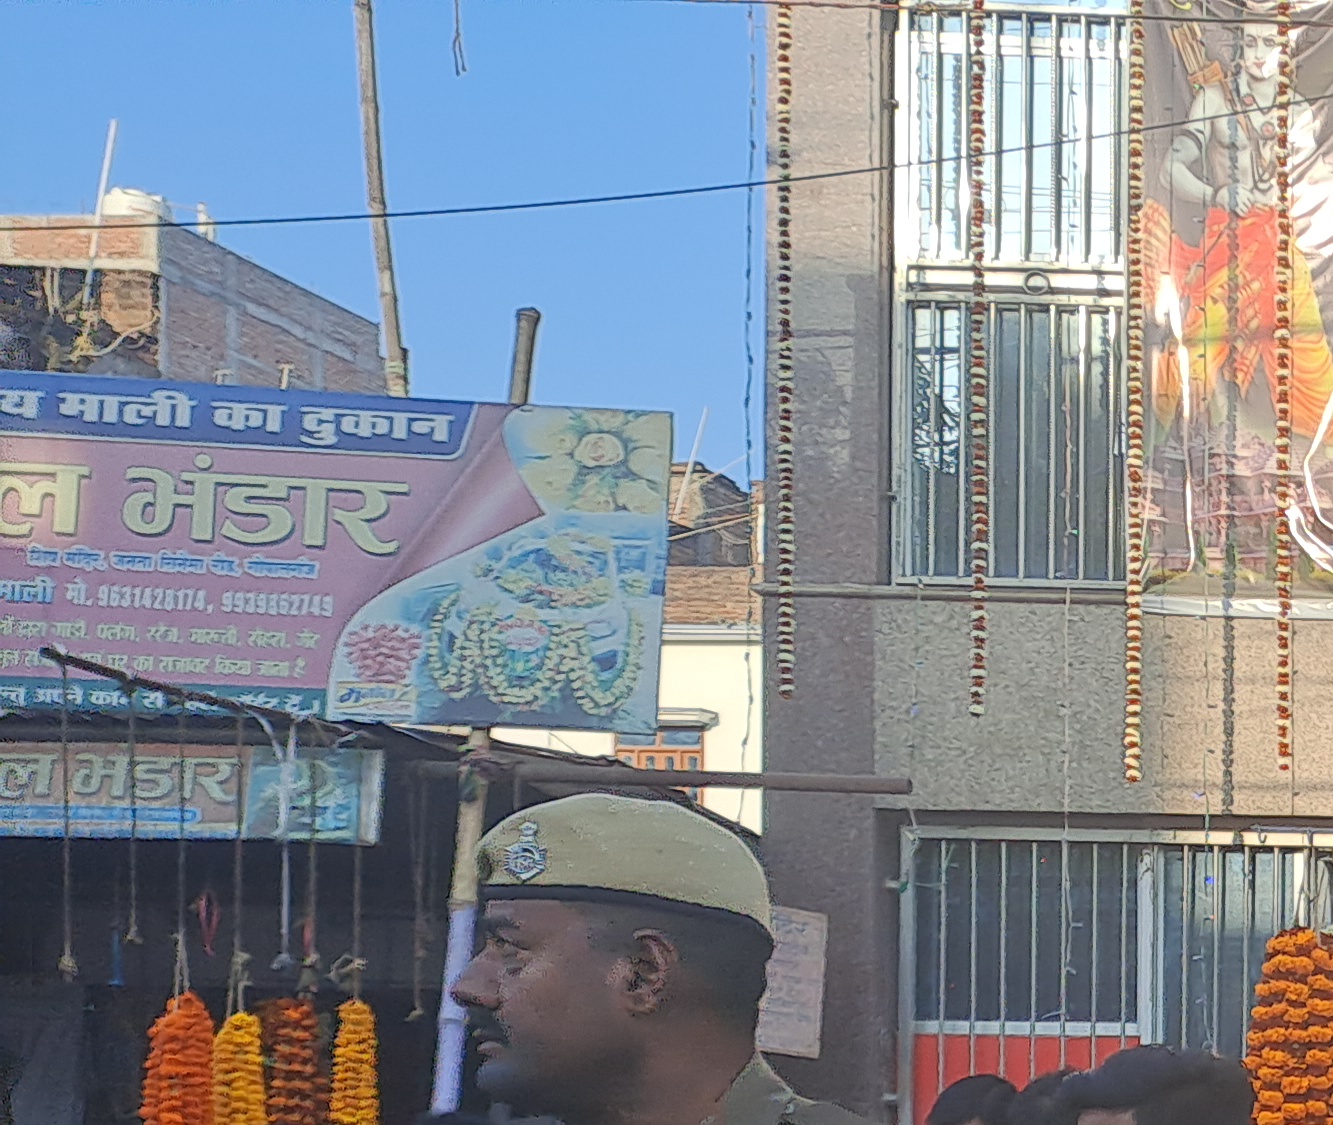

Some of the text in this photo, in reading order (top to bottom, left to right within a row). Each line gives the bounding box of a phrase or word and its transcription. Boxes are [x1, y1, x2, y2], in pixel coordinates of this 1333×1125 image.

[56, 389, 198, 428] माली
[210, 401, 289, 433] का
[300, 406, 455, 446] दुकान
[121, 453, 409, 554] भंडार
